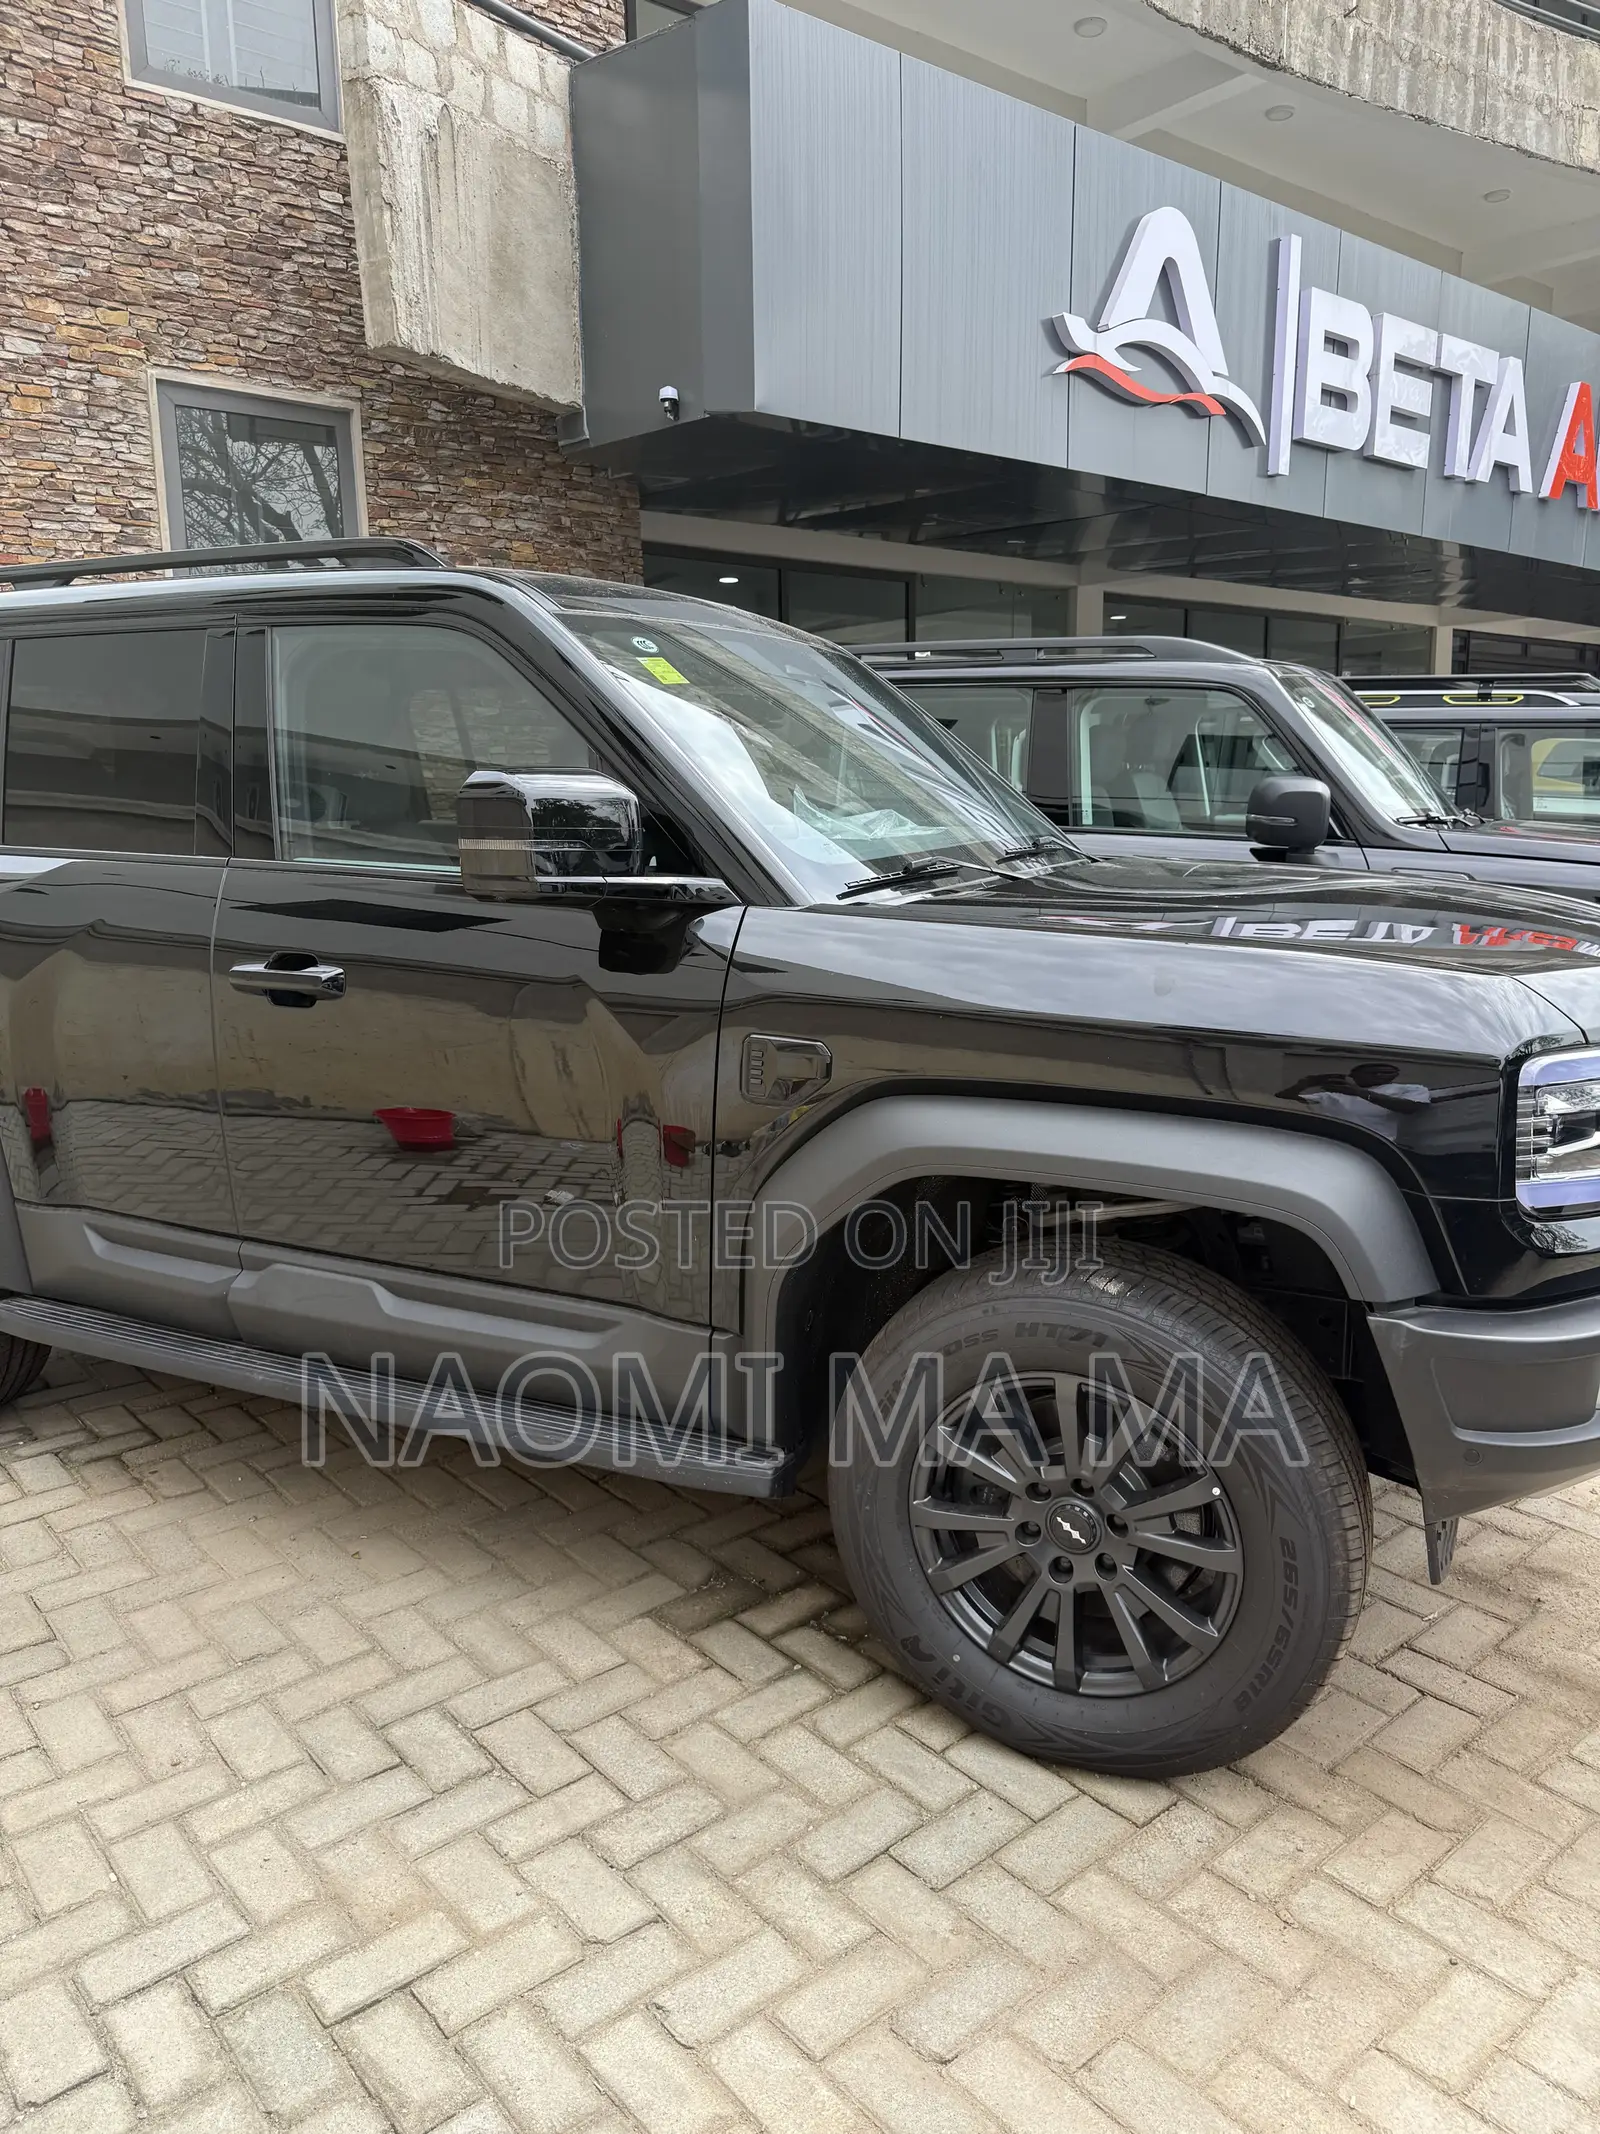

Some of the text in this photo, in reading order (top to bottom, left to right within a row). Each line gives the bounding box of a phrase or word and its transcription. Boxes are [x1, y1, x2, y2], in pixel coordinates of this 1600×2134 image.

[1293, 286, 1600, 511] BETA A
[1014, 1321, 1109, 1348] HT71
